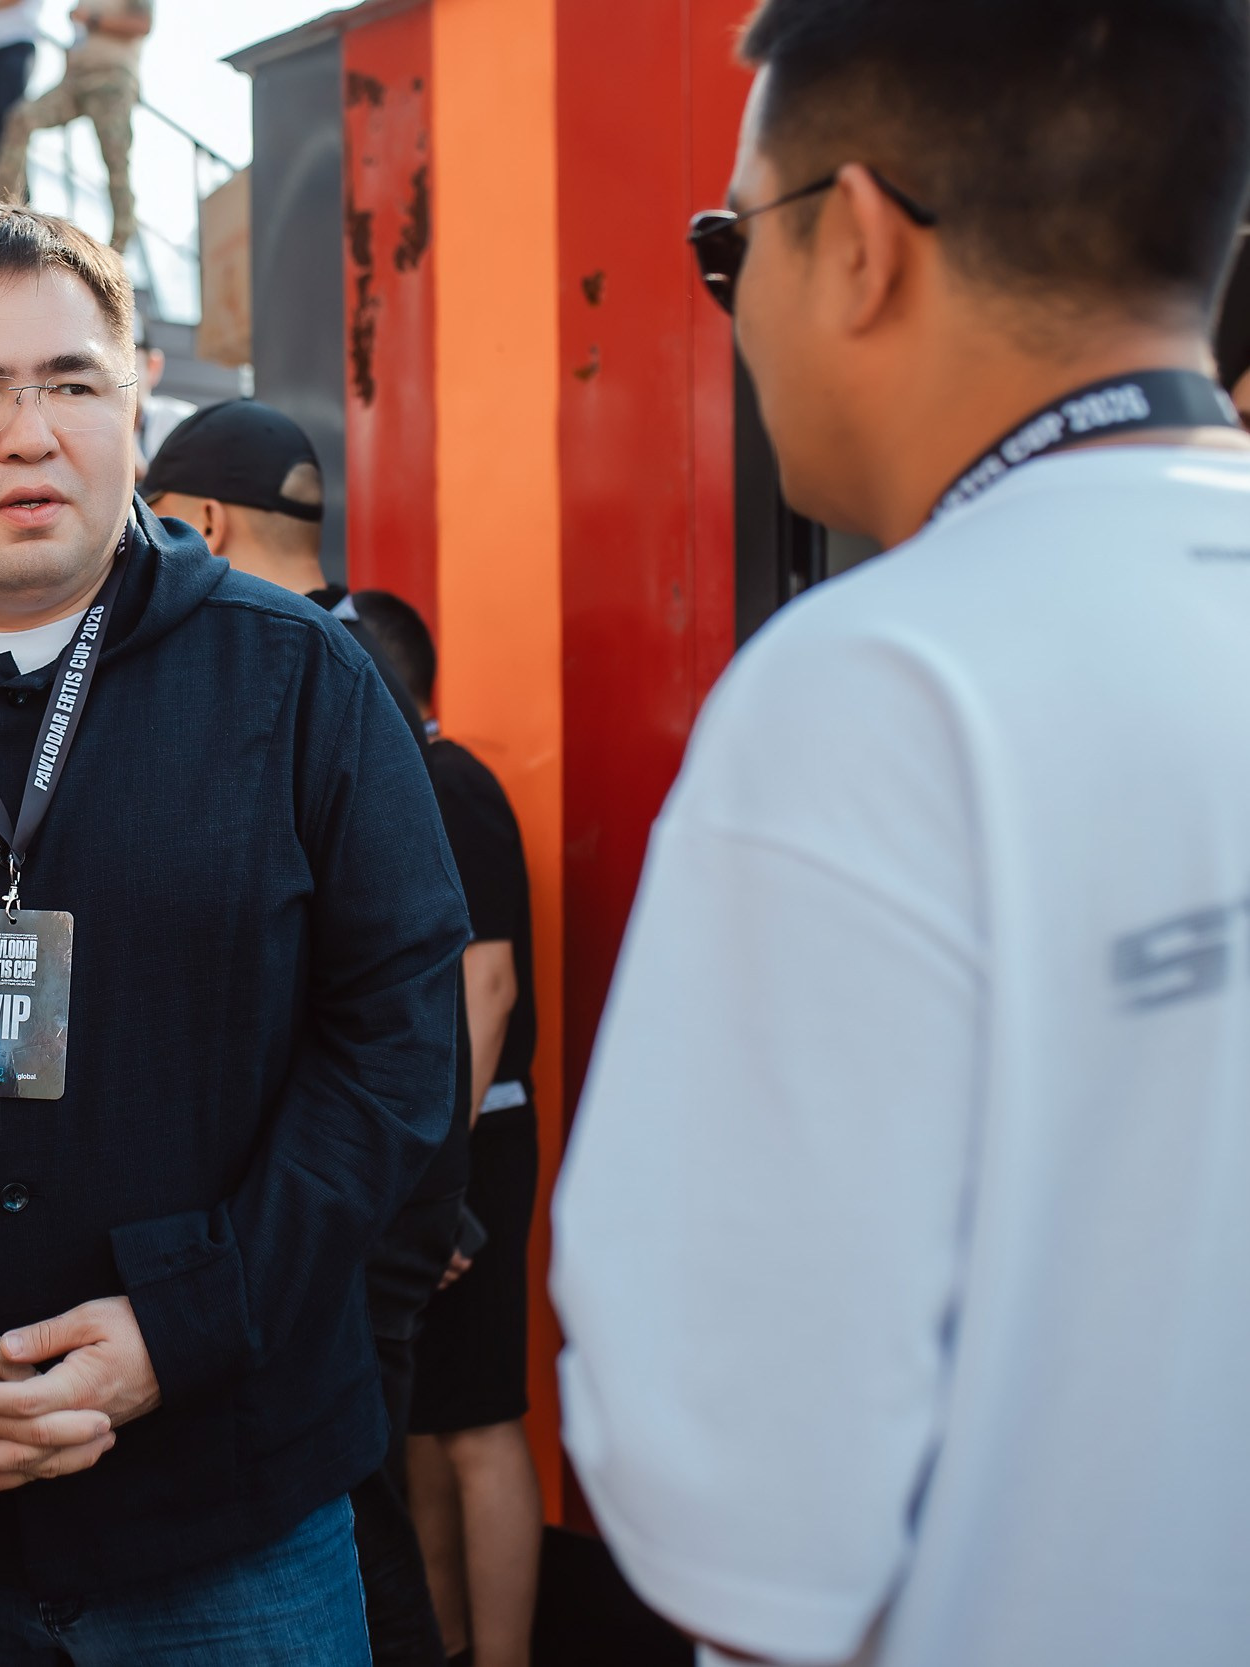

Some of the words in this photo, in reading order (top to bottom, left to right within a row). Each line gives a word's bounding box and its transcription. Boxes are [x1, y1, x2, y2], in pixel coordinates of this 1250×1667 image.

[1000, 411, 1066, 464] CUP
[1061, 383, 1151, 433] 2026
[80, 605, 105, 642] 2026
[70, 641, 92, 671] CUP
[56, 670, 83, 715] ERTIS
[34, 712, 70, 792] PAVLODAR
[13, 960, 36, 979] CUP
